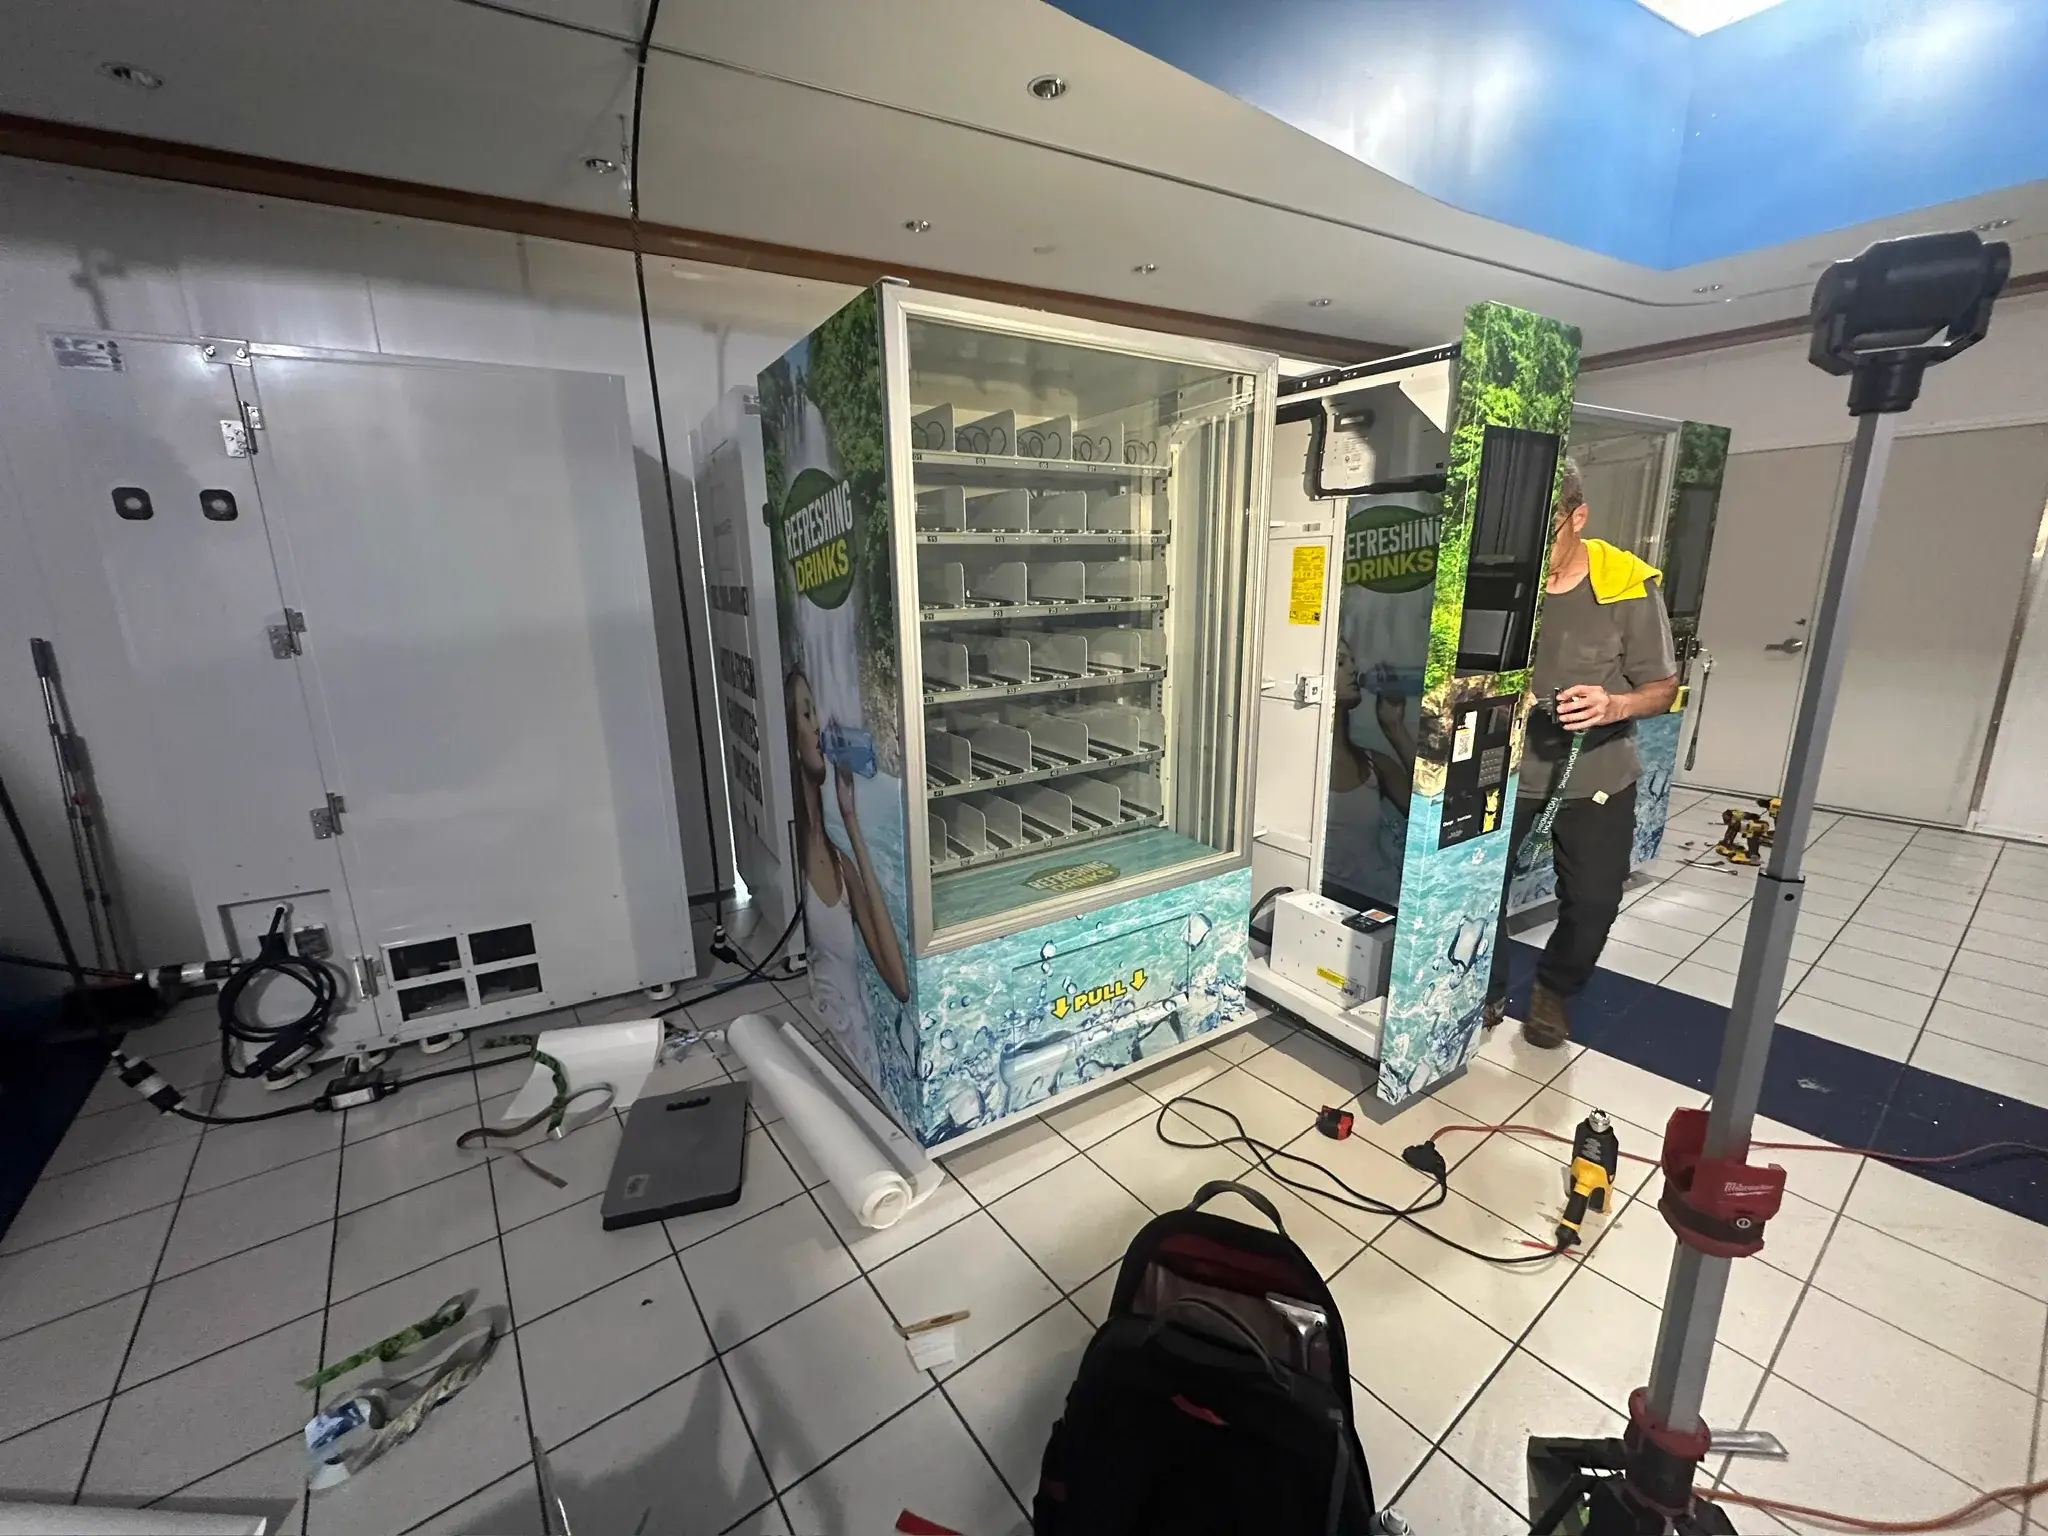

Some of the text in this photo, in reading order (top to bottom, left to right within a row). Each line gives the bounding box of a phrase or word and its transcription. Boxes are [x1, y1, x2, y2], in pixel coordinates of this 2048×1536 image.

[783, 479, 853, 560] REFRESHING
[1345, 514, 1443, 560] EFRESHIN
[794, 538, 850, 592] DRINKS
[1345, 549, 1434, 583] DRINKS
[1027, 860, 1109, 890] REFRESHING
[1050, 868, 1113, 892] DRINKS
[1073, 980, 1127, 1012] PULL
